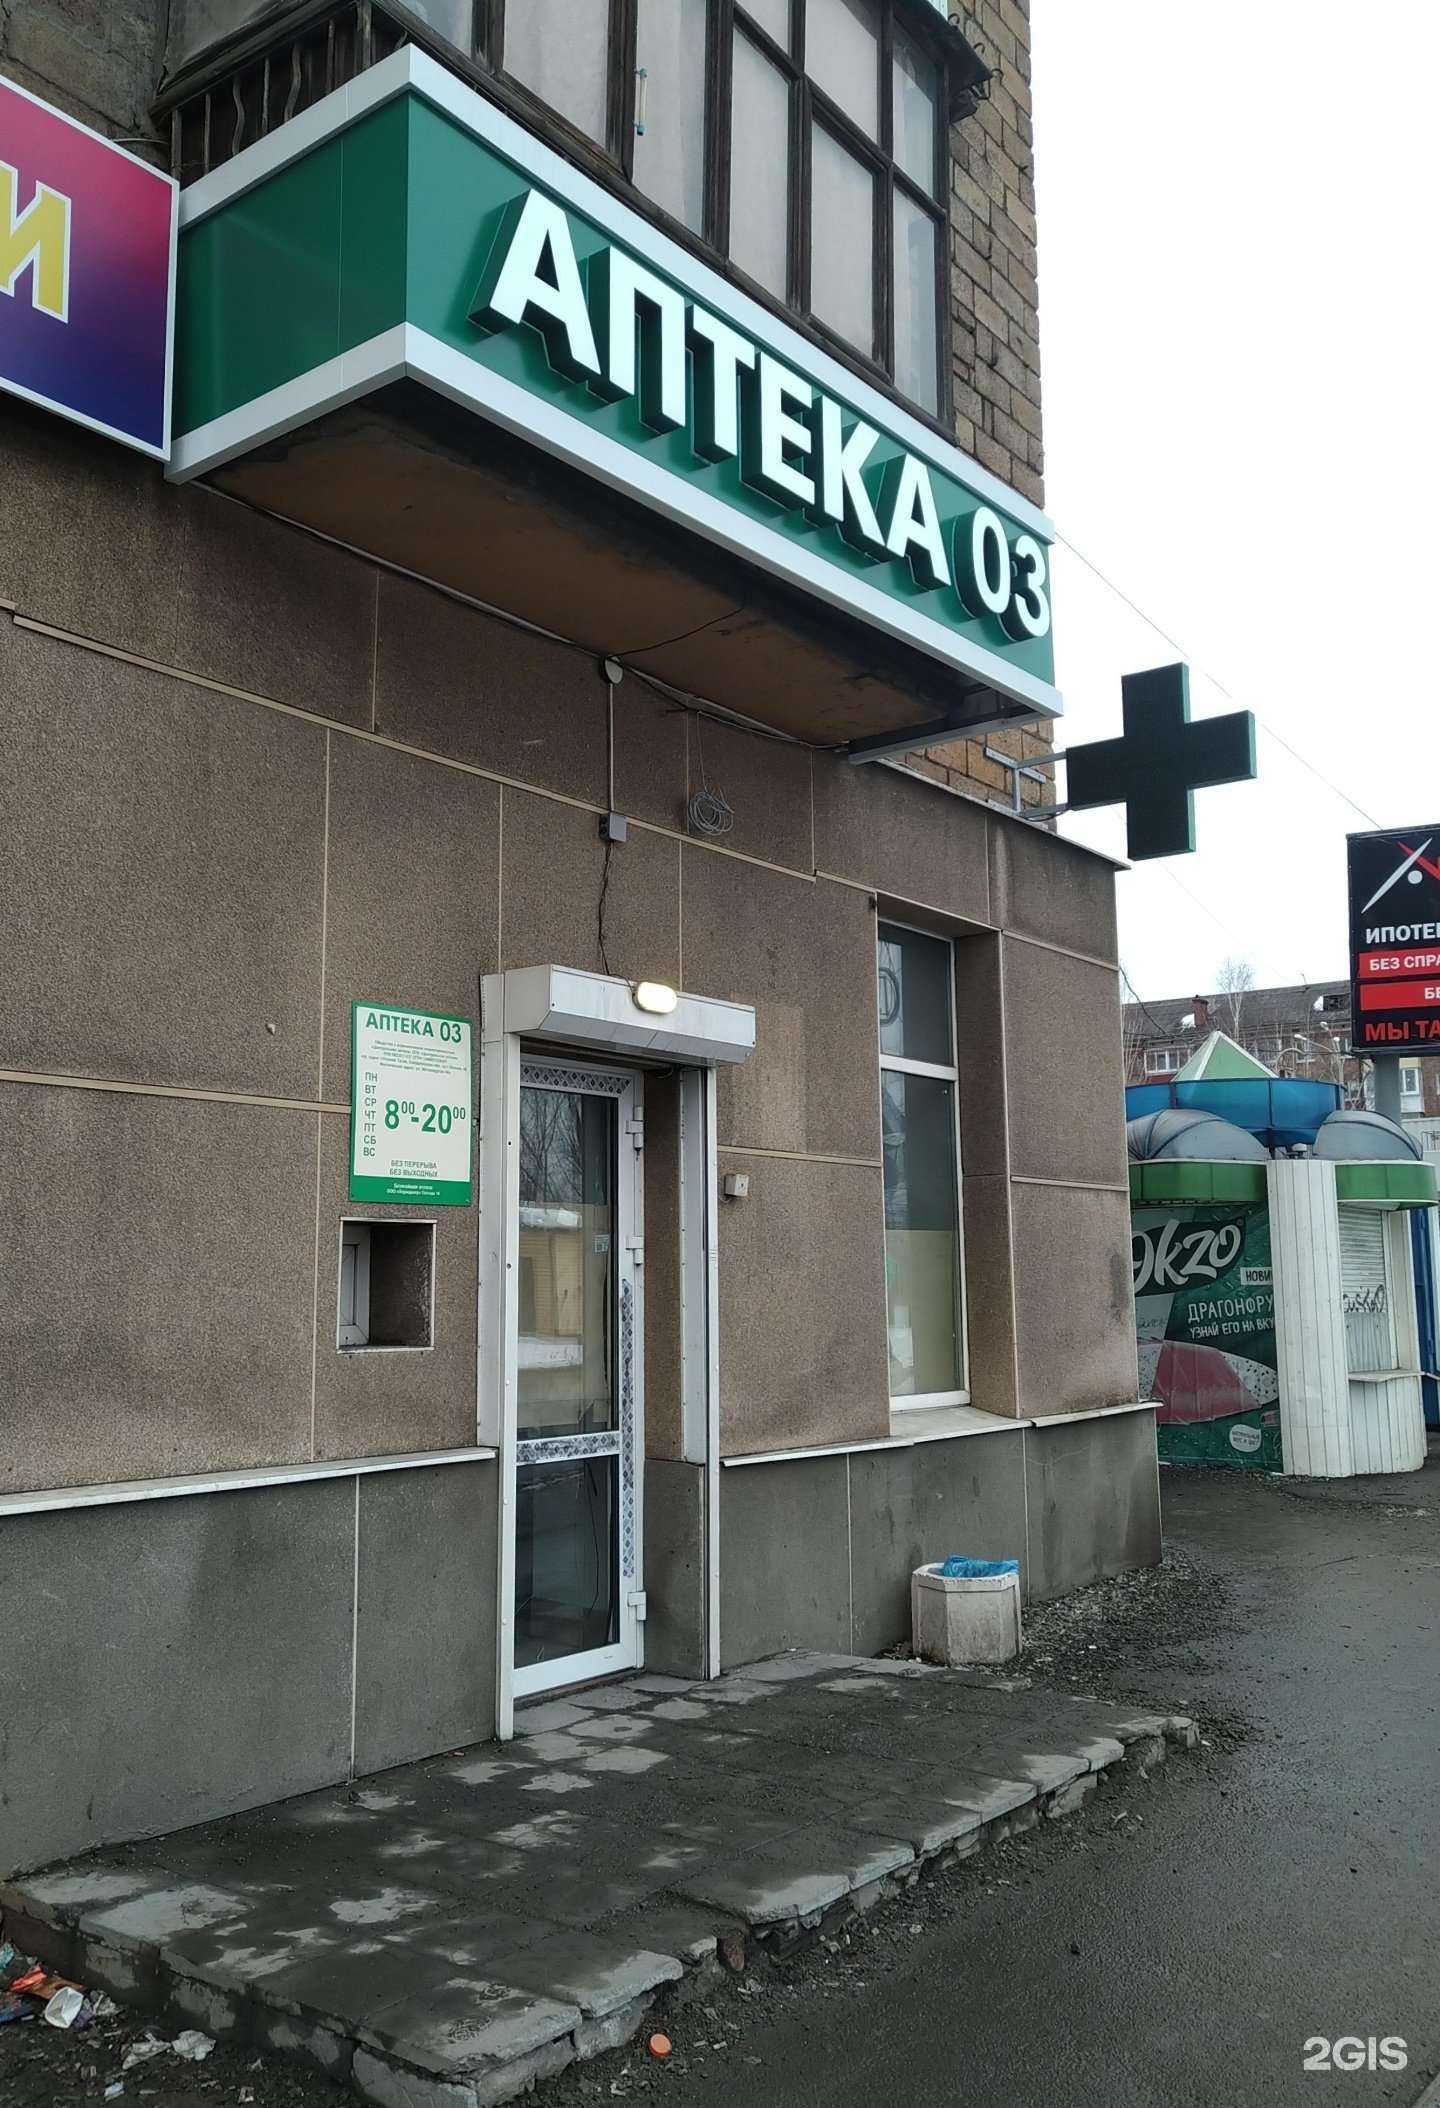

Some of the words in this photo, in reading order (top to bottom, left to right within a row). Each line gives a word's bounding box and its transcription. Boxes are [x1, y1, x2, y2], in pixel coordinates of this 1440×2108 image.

[489, 188, 952, 587] АПТЕКА
[972, 506, 1051, 637] 03
[1369, 957, 1400, 971] БЕЗ
[365, 1012, 434, 1037] АПТЕКА
[439, 1021, 462, 1043] 03
[1365, 1022, 1409, 1041] МЫ
[365, 1071, 378, 1081] ПН
[365, 1084, 377, 1094] ВТ
[364, 1097, 377, 1107] СР
[364, 1109, 376, 1120] ЧТ
[363, 1122, 376, 1132] ПТ
[363, 1135, 376, 1145] СБ
[363, 1147, 376, 1157] ВС
[390, 1159, 403, 1167] БЕЗ
[389, 1168, 402, 1176] БЕЗ
[1245, 1270, 1273, 1281] НОВИ
[1190, 1322, 1220, 1339] УЗНАЙ
[1222, 1321, 1240, 1335] ЕГО
[1241, 1321, 1255, 1332] НА
